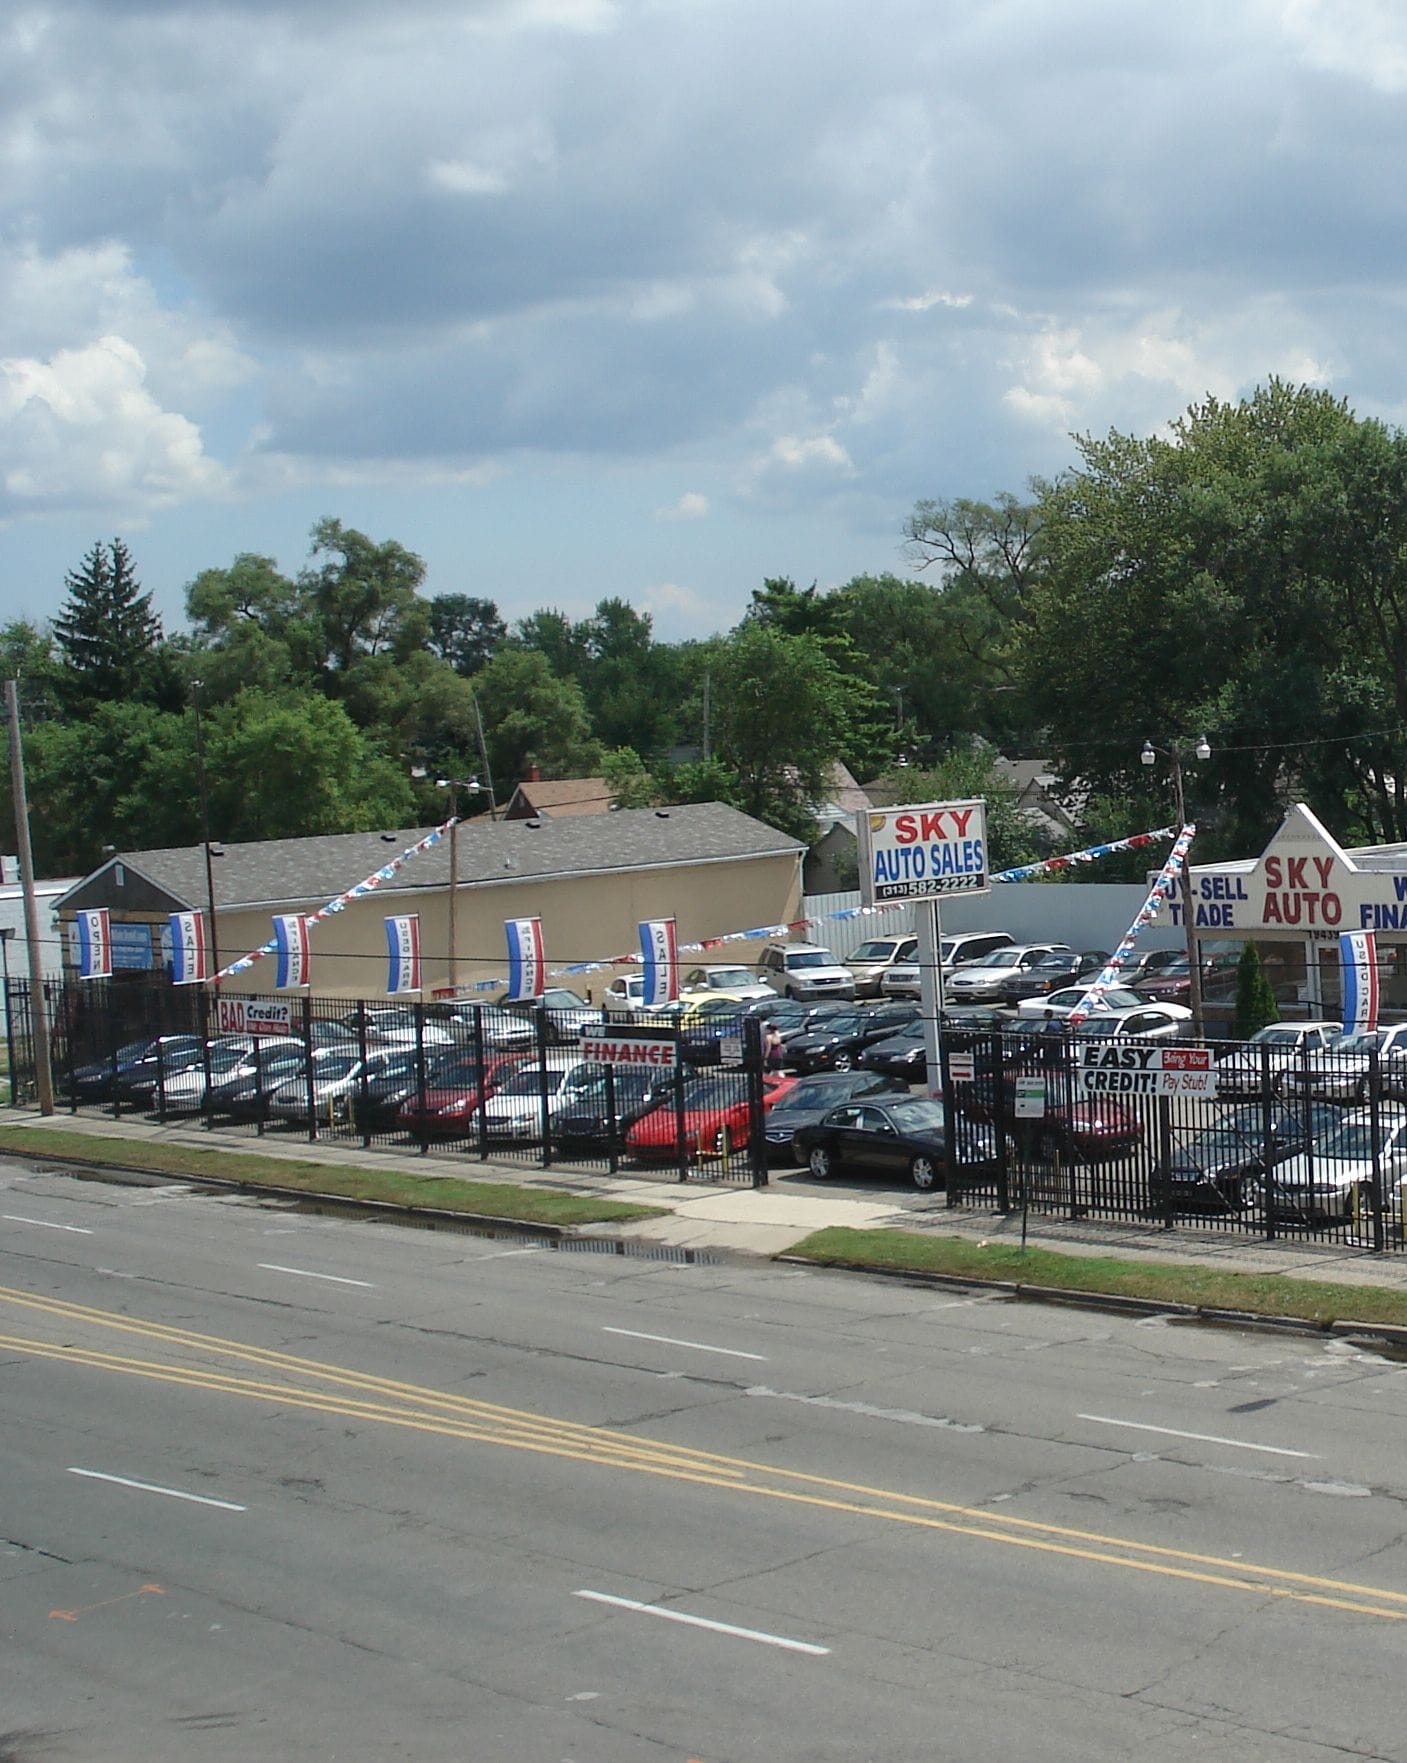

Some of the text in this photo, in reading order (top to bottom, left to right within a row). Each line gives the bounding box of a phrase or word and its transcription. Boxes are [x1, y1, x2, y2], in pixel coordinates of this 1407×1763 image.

[895, 809, 973, 844] SKY
[875, 839, 983, 882] AUTO SALES
[1264, 856, 1335, 889] SKY
[1169, 903, 1234, 927] TADE
[1262, 892, 1342, 925] AUTO
[220, 1001, 245, 1033] BAD
[246, 1005, 288, 1020] Credit?
[583, 1042, 674, 1064] FINANCE
[1084, 1046, 1157, 1069] EASY
[1188, 1052, 1209, 1066] Your
[1084, 1070, 1157, 1093] CREDIT!
[1162, 1072, 1209, 1094] Pay Stub!
